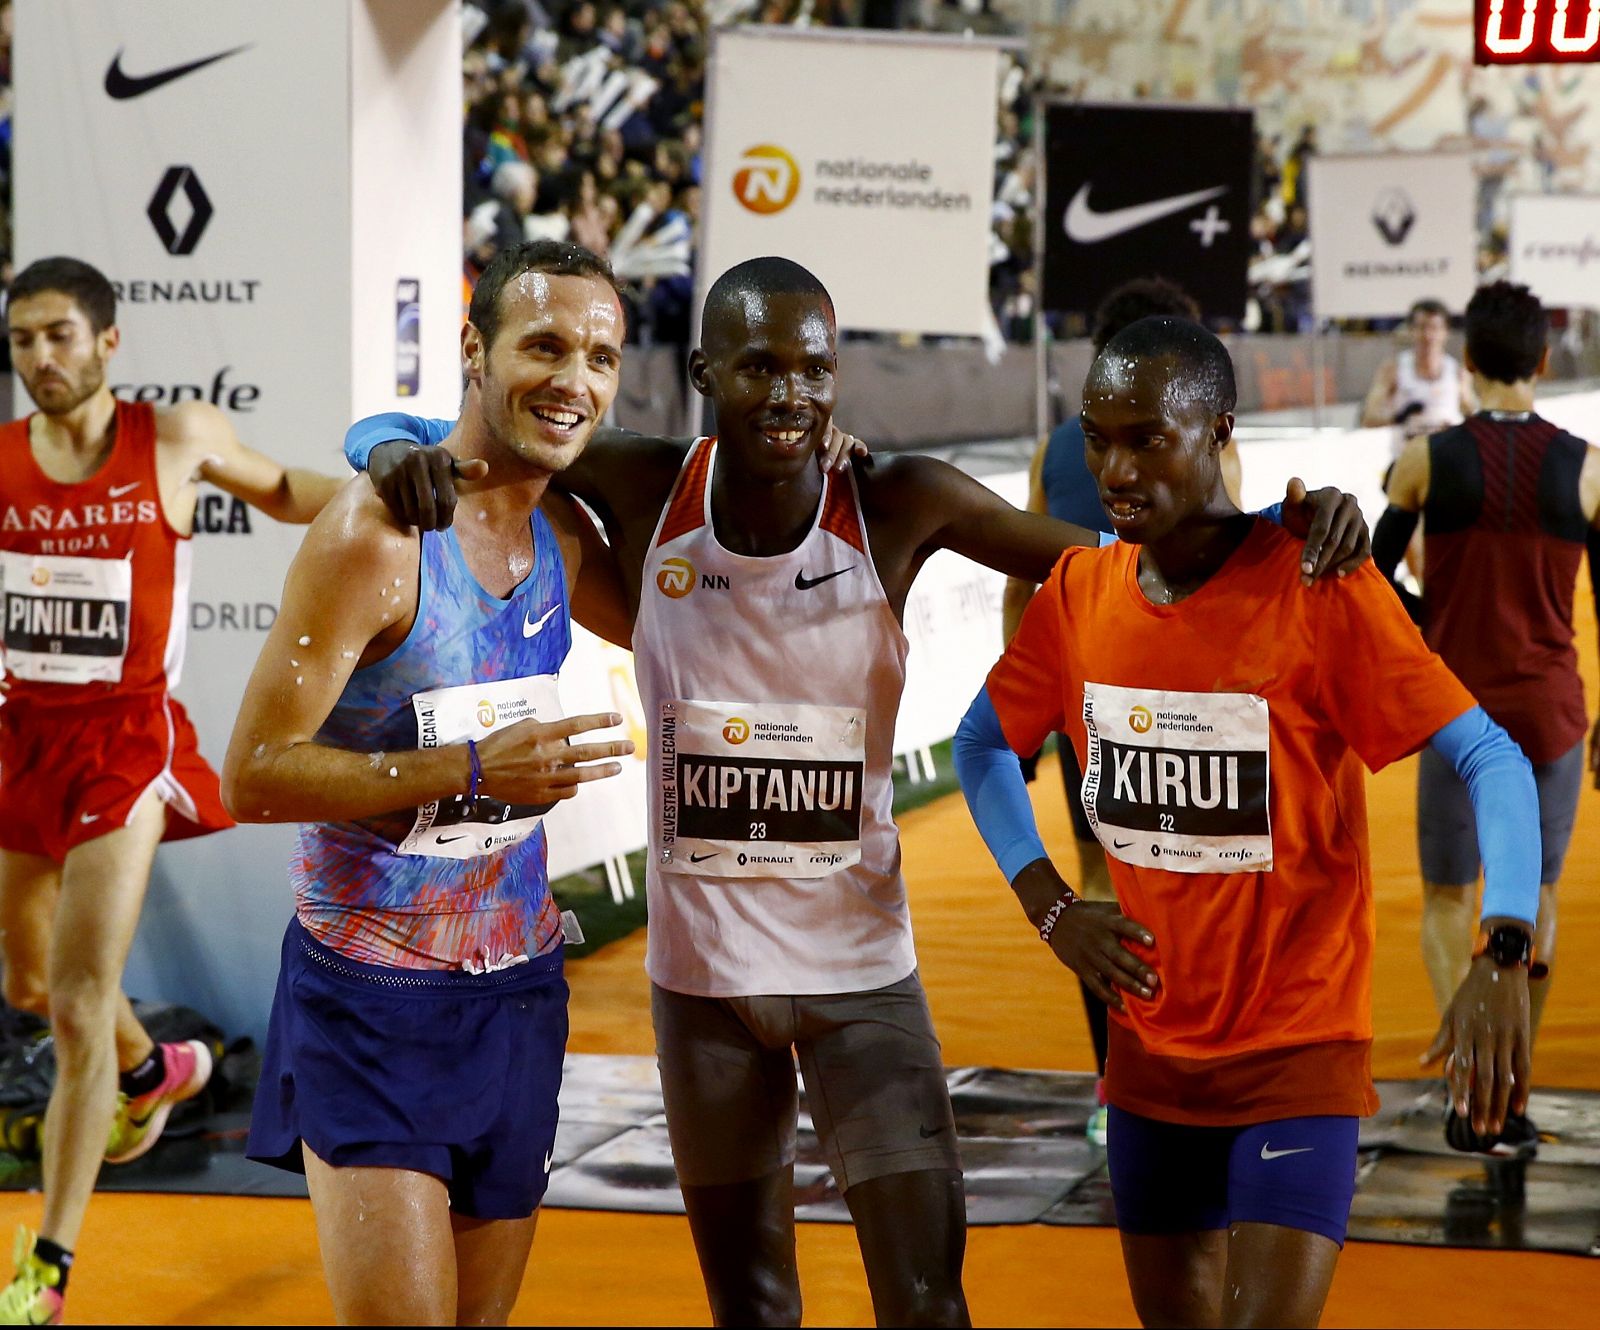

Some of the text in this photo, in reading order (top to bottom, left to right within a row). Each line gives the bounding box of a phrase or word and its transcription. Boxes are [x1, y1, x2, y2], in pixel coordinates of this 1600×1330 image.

[815, 158, 932, 182] nationale
[815, 185, 971, 212] nederlanden
[112, 280, 261, 302] RENAULT
[2, 501, 157, 531] AÑARES
[41, 534, 110, 553] RIOJA
[702, 574, 730, 590] NN
[9, 596, 118, 639] PINILLA
[191, 602, 278, 631] DRID
[499, 707, 536, 721] nederlanden
[1156, 711, 1197, 722] nationale
[754, 722, 798, 733] nationale
[1156, 721, 1213, 733] nederlanden
[754, 732, 813, 743] nederlanden
[683, 764, 854, 812] KIPTANUI
[1112, 747, 1239, 810] KIRUI
[1083, 769, 1100, 830] SILVESTRE
[663, 785, 676, 843] SILVESTRE
[1159, 813, 1175, 832] 22
[750, 822, 766, 839] 23
[750, 853, 843, 866] RENAULT renfe
[1163, 848, 1252, 861] RENAULT renfe
